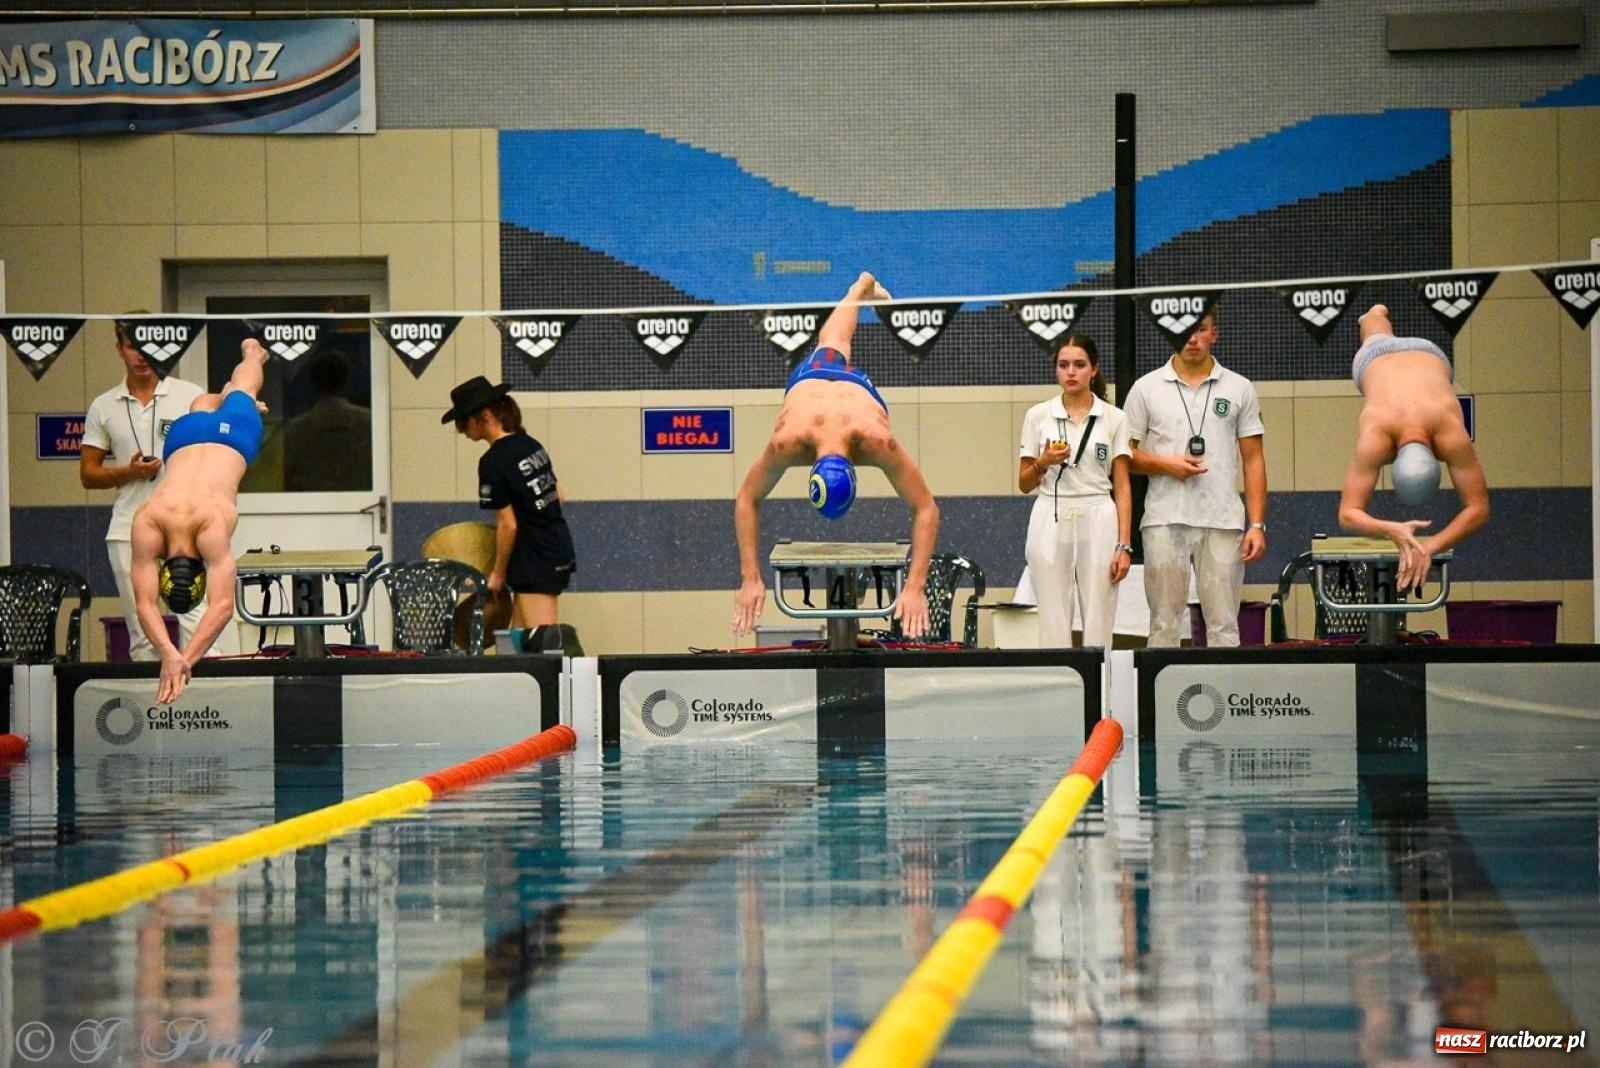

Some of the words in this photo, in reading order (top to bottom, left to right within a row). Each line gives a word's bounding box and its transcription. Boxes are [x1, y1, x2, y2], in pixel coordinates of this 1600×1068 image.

[0, 43, 57, 87] MS
[67, 29, 284, 86] RACIBÓRZ
[1293, 289, 1346, 307] arena
[1425, 281, 1478, 299] arena
[1022, 303, 1075, 322] arena
[1151, 297, 1204, 315] arena
[638, 318, 690, 335] arena
[764, 314, 816, 332] arena
[891, 309, 944, 328] arena
[12, 325, 65, 341] arena
[135, 325, 188, 341] arena
[264, 325, 316, 341] arena
[390, 323, 443, 340] arena
[510, 321, 562, 338] arena
[672, 415, 702, 428] NIE
[656, 432, 719, 445] BIEGAJ
[297, 577, 312, 617] 3
[830, 575, 848, 609] 4
[693, 712, 719, 722] TIME
[1229, 707, 1256, 717] TIME
[148, 719, 175, 730] TIME
